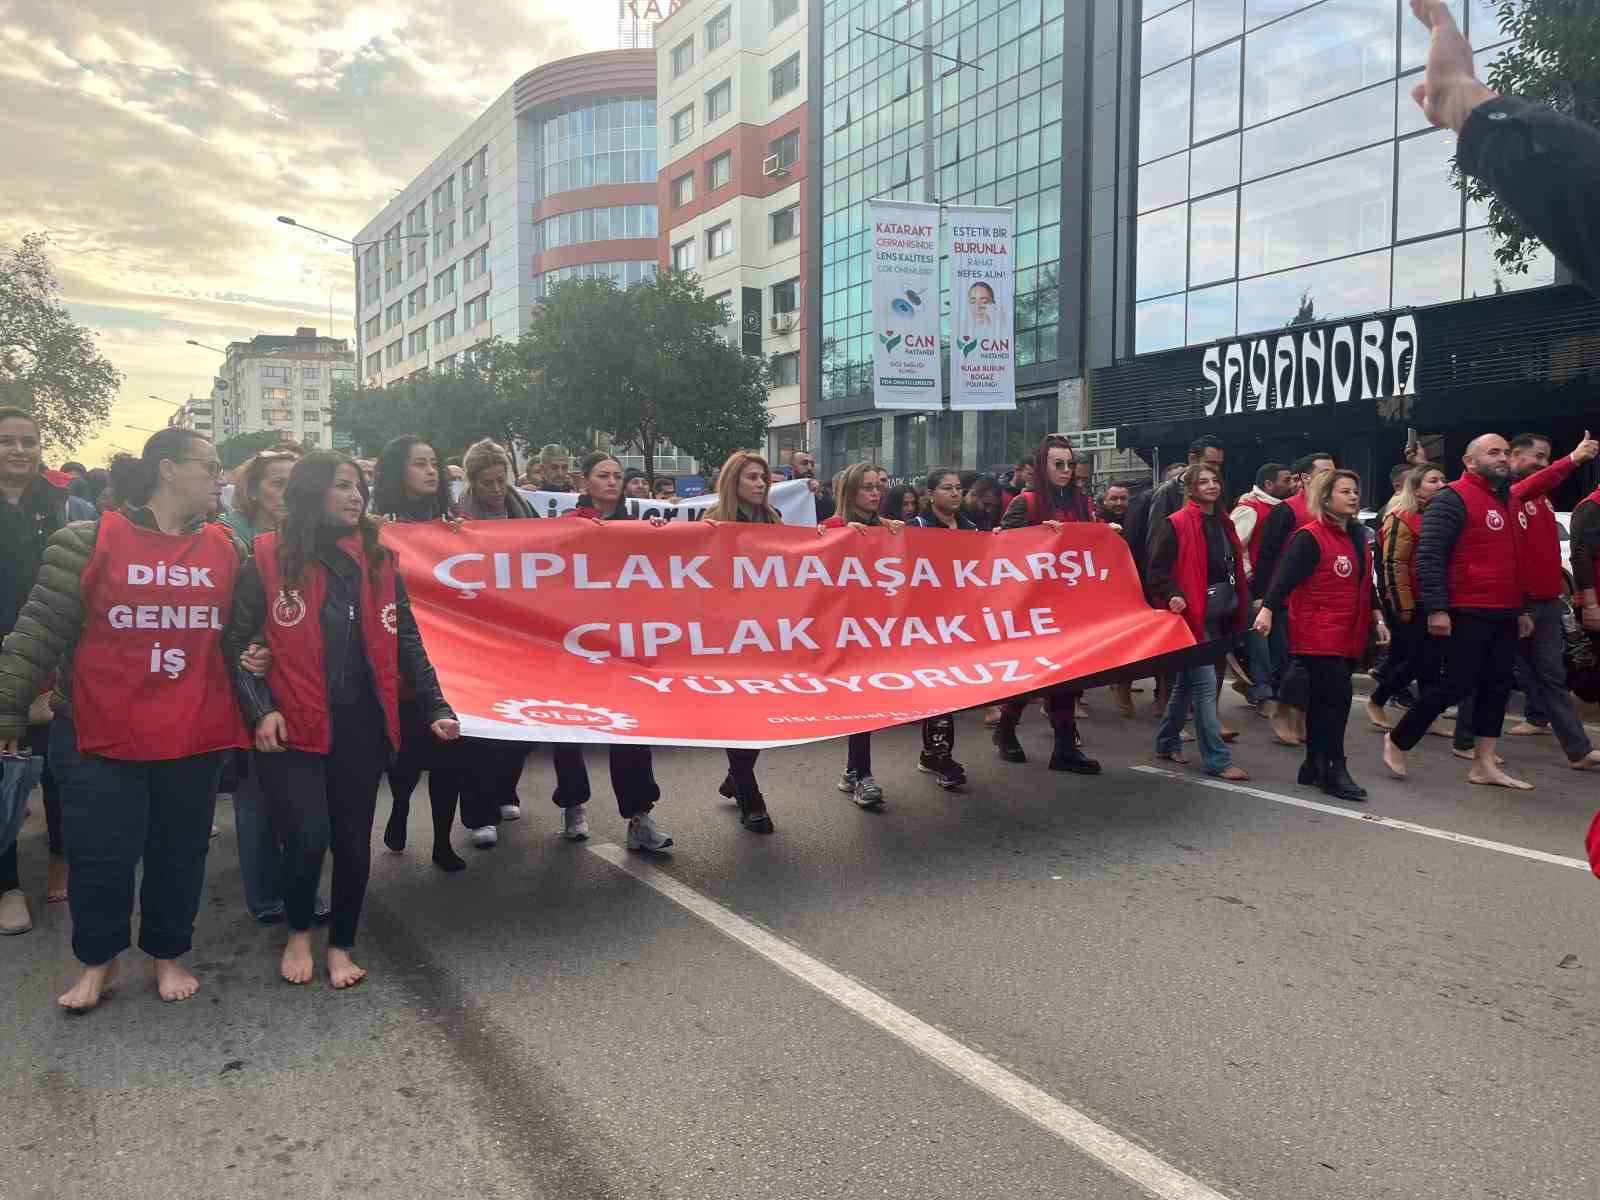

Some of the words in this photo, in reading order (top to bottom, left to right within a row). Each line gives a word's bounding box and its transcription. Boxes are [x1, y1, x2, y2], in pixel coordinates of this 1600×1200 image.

[876, 223, 934, 237] KATARAKT
[954, 242, 1007, 255] BURUNLA
[904, 334, 935, 348] CAN
[980, 339, 1009, 351] CAN
[1202, 314, 1418, 416] SAYANORA
[127, 560, 215, 588] DİSK
[433, 552, 714, 600] ÇIPLAK
[732, 555, 941, 596] MAAŞA
[952, 550, 1109, 588] KARŞI,
[108, 604, 224, 630] GENEL
[563, 617, 821, 664] ÇIPLAK
[835, 614, 977, 648] AYAK
[982, 606, 1062, 642] İLE
[150, 641, 186, 679] İŞ
[628, 656, 1035, 694] YÜRÜYORUZ
